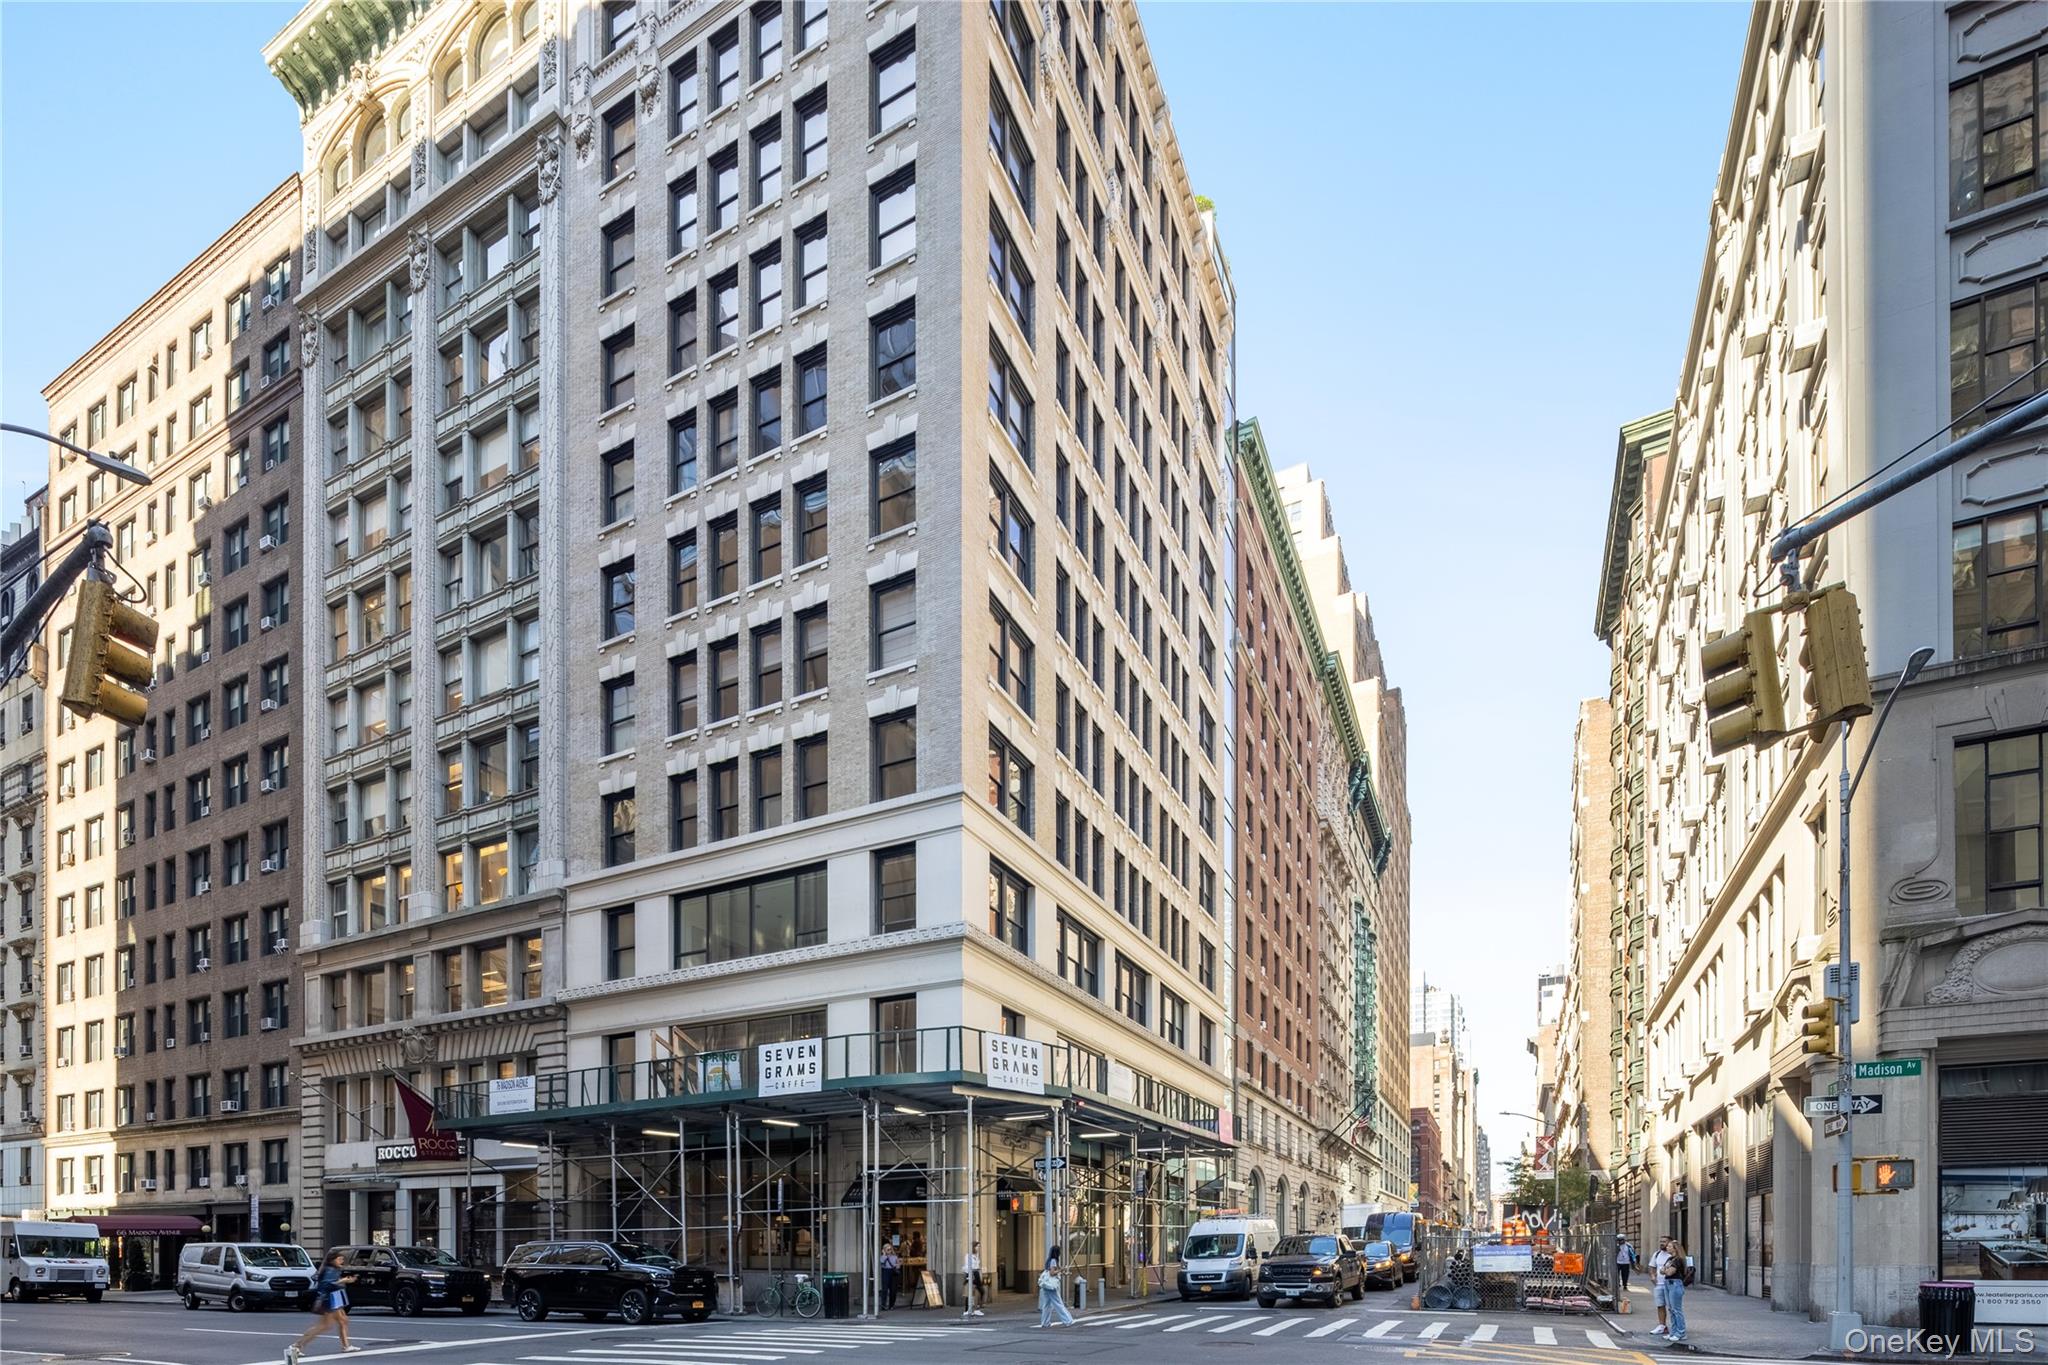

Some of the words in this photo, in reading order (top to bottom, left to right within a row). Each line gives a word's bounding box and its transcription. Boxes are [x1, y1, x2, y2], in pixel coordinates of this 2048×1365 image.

[765, 1045, 816, 1062] SEVEN
[992, 1040, 1037, 1060] SEVEN
[765, 1062, 816, 1079] GRAMS
[992, 1057, 1039, 1076] GRAMS
[1859, 1064, 1902, 1076] Madison
[1906, 1061, 1917, 1069] Av
[1815, 1102, 1837, 1110] ONE
[377, 1145, 417, 1160] ROCCO
